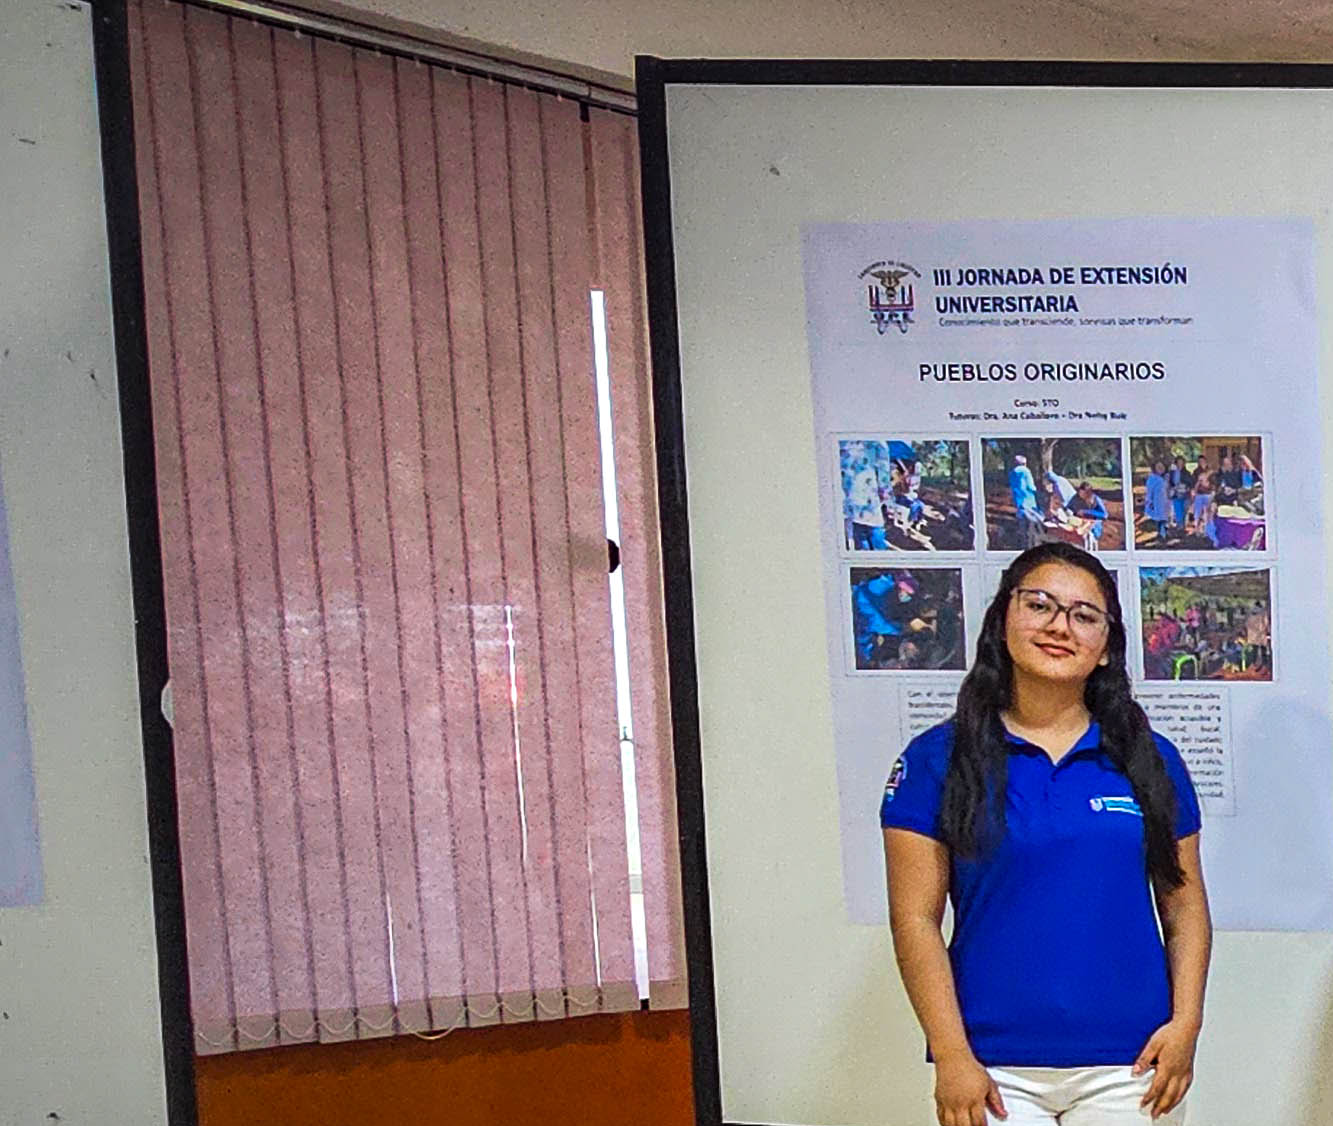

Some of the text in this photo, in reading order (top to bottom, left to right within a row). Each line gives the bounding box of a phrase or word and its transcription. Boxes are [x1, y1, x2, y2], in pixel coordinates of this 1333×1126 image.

[933, 269, 951, 286] III
[956, 268, 1045, 286] JORNADA
[1050, 267, 1075, 285] DE
[1080, 262, 1187, 285] EXTENSIÓN
[935, 295, 1079, 313] UNIVERSITARIA
[919, 362, 1165, 382] PUEBLOS ORIGINARIOS
